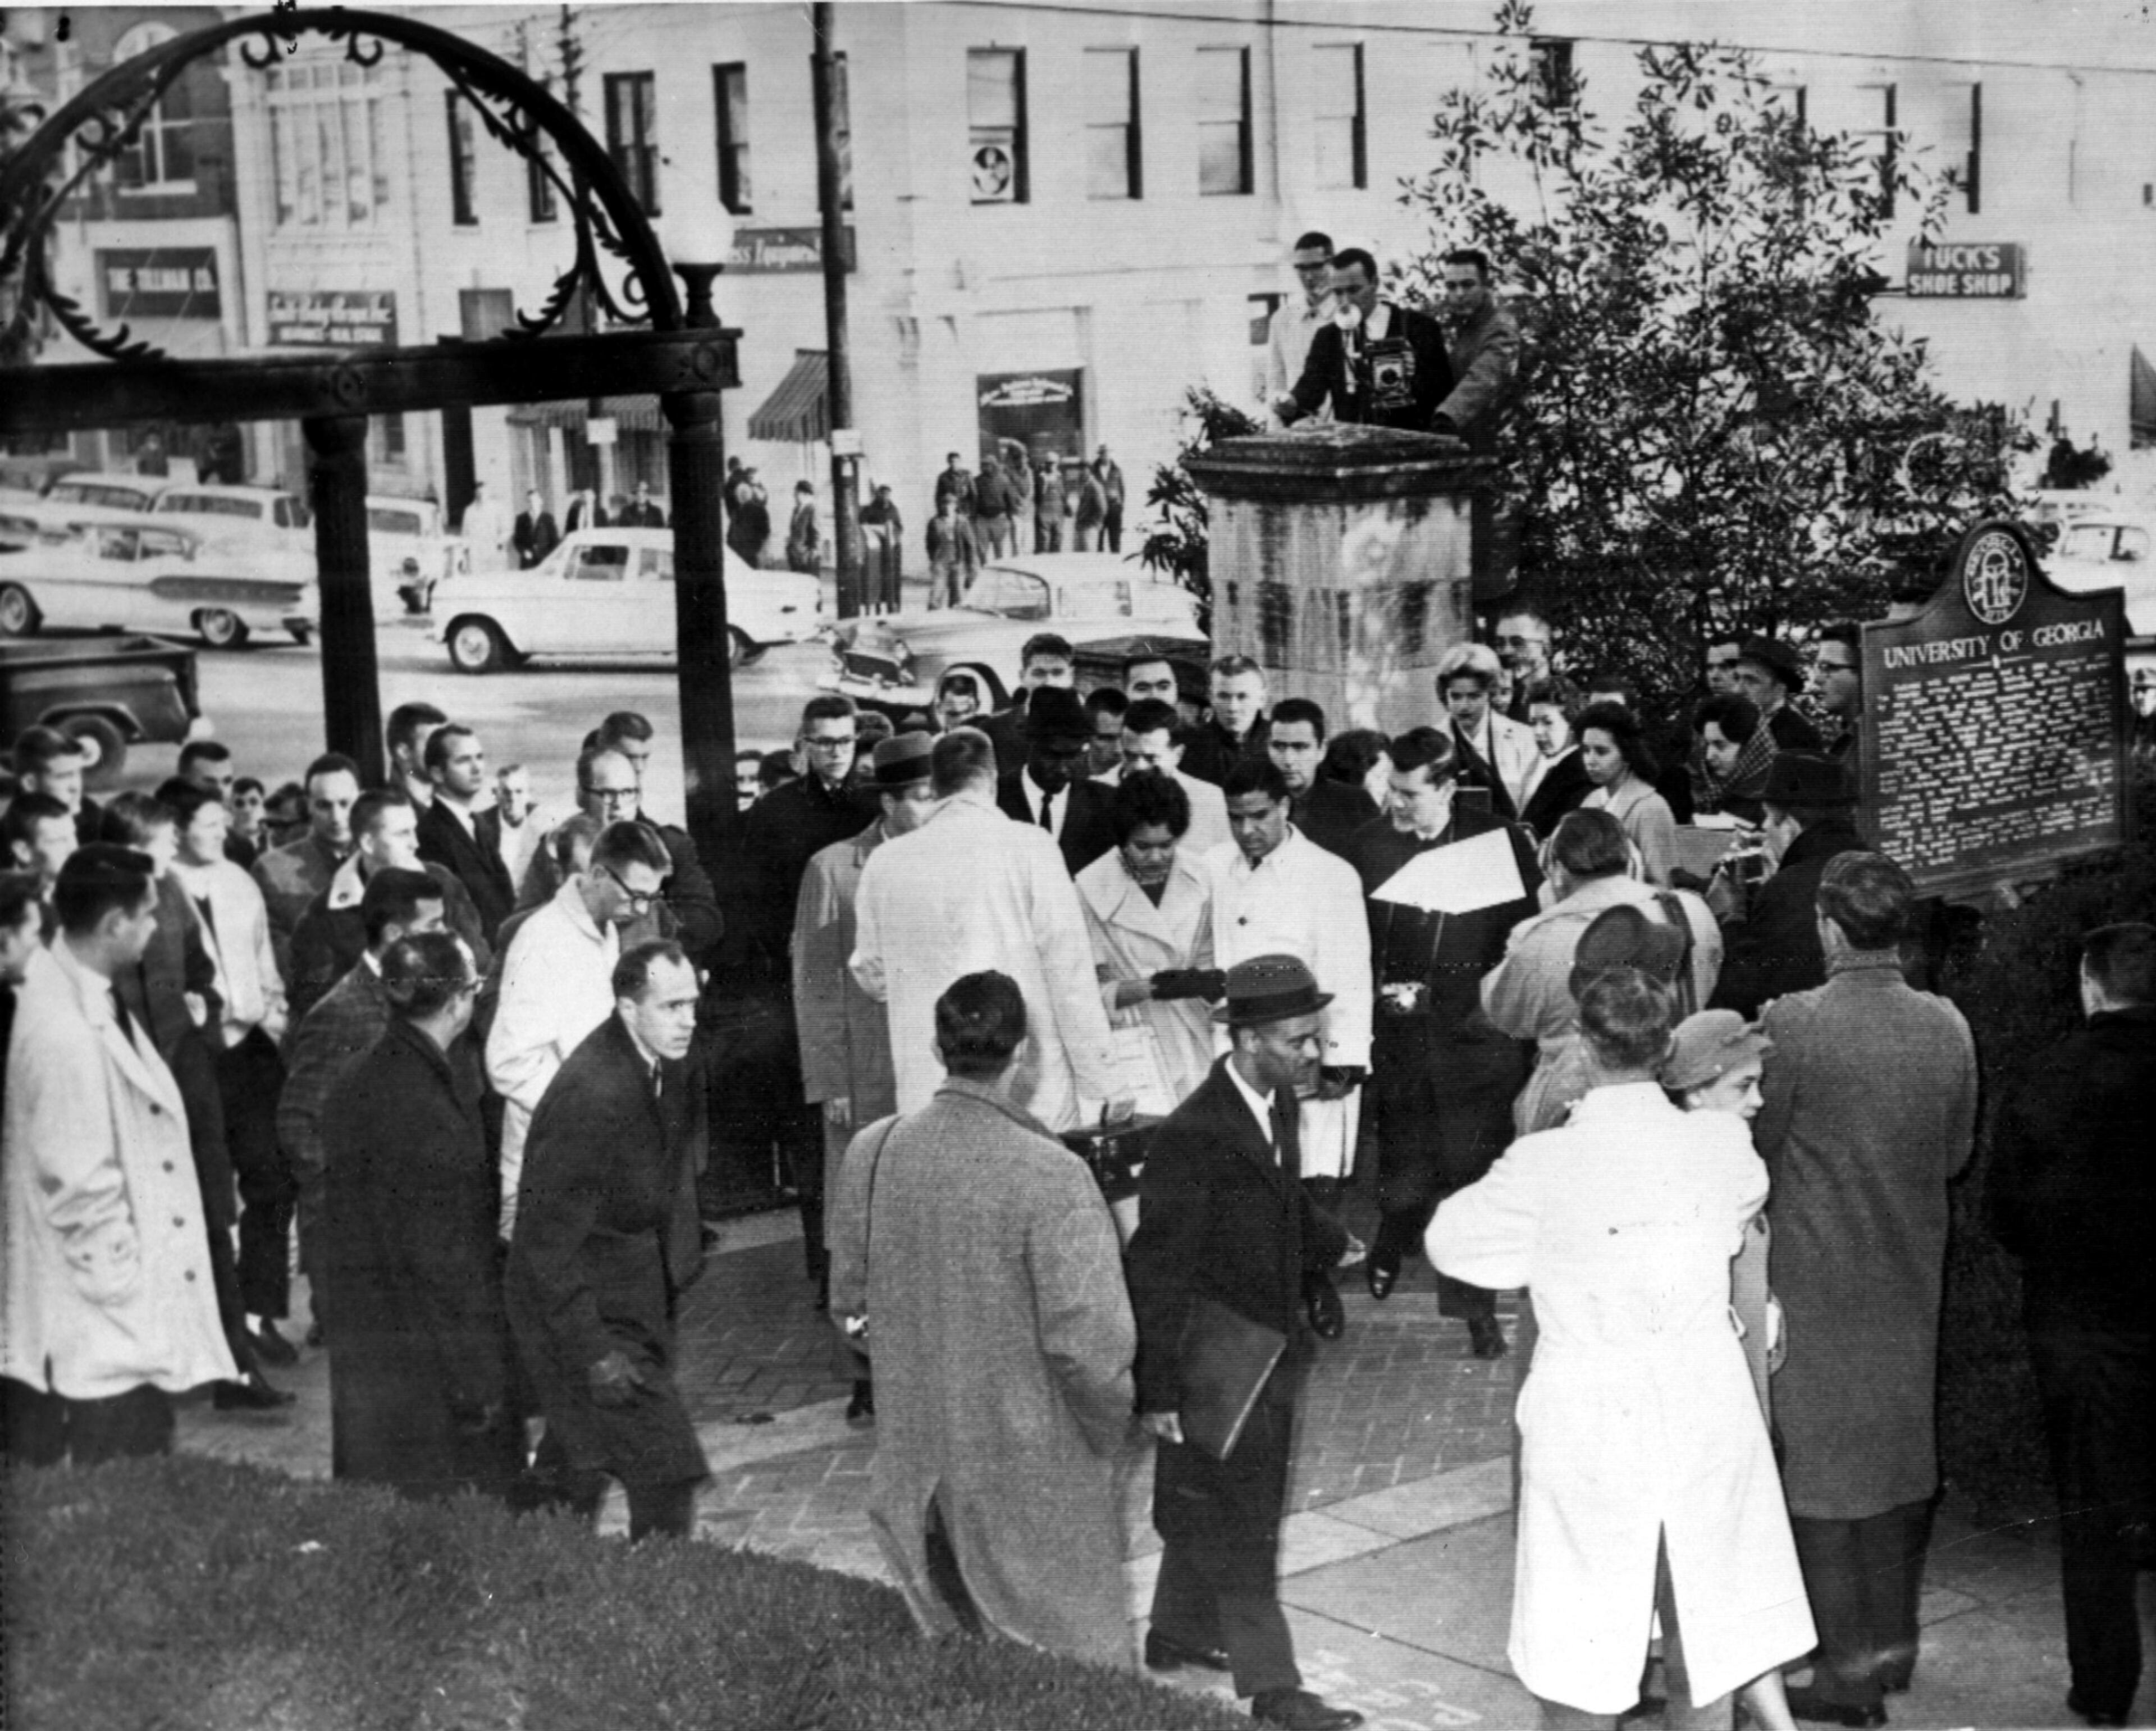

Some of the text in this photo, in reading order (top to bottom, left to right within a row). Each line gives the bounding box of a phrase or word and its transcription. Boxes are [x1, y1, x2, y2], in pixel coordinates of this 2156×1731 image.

[1909, 273, 2012, 295] SHOE SHOP
[1883, 618, 2104, 669] UNIVERSITY OF GEORGIA
